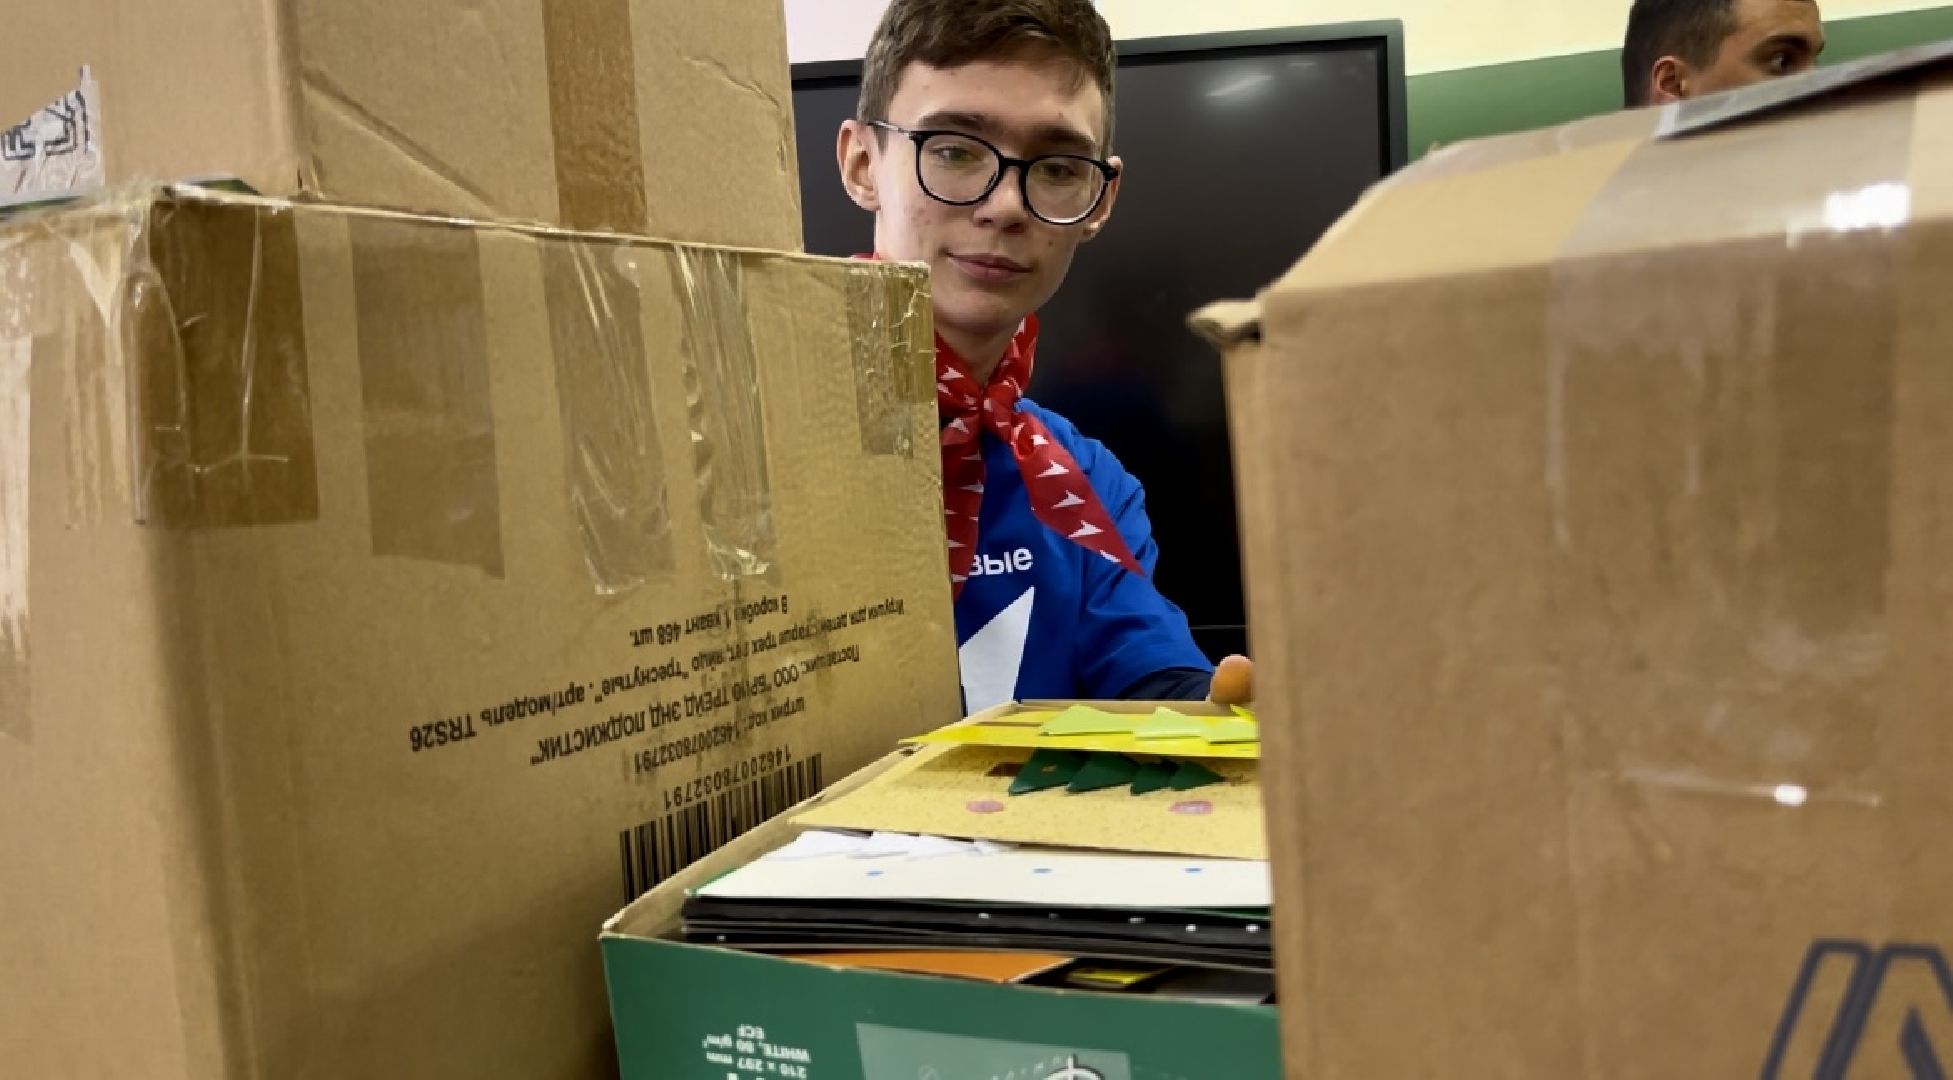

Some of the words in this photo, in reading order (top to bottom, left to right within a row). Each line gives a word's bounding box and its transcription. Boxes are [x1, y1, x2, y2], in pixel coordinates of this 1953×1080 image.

[781, 595, 788, 614] В
[868, 598, 904, 620] Игрушки
[685, 612, 722, 635] квант
[726, 610, 731, 629] 1
[821, 614, 847, 633] детей
[850, 607, 867, 625] для
[630, 628, 652, 648] шт.
[657, 623, 681, 644] 468
[774, 665, 799, 687] ООО
[480, 682, 585, 727] арт/модель
[684, 688, 729, 717] ТРЕЙД
[771, 697, 804, 721] штрих
[650, 701, 681, 729] ЭНД
[409, 713, 477, 752] TRS26
[634, 724, 741, 774] 14620078032791
[663, 744, 791, 810] 14620078032791
